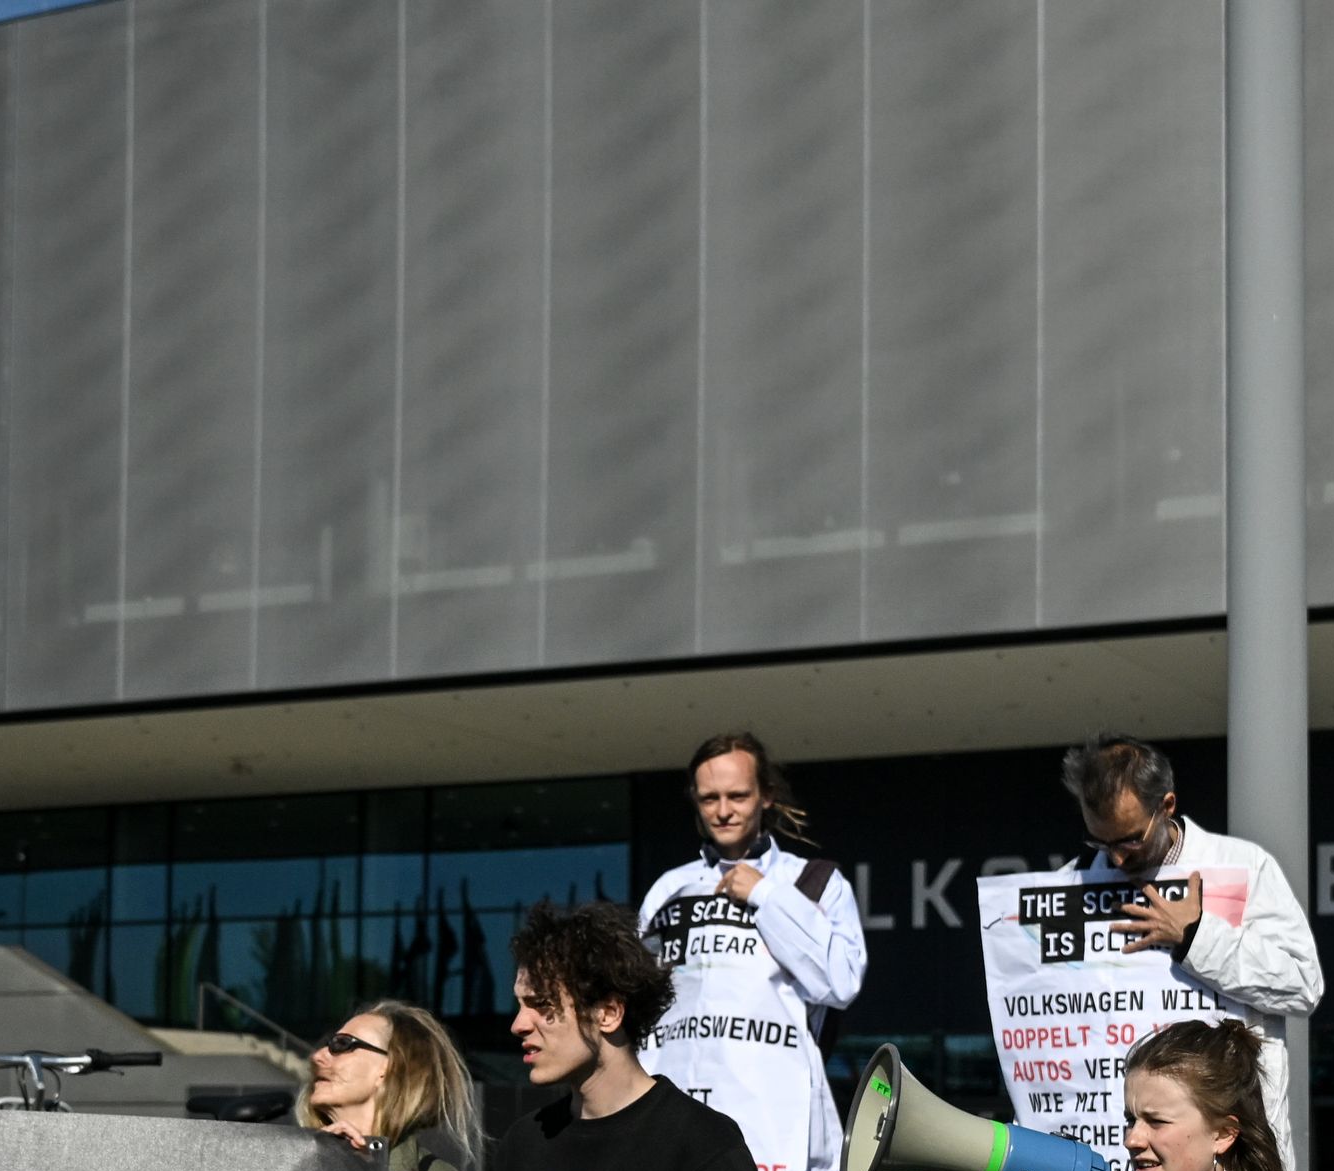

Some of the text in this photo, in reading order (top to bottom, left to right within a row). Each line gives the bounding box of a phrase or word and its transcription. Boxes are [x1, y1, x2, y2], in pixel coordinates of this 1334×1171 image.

[1021, 893, 1066, 918] THE
[663, 939, 681, 963] IS
[690, 934, 757, 956] CLEAR
[1044, 932, 1075, 957] IS
[1003, 988, 1228, 1017] VOLKSWAGEN WILL
[1002, 1024, 1091, 1050] DOPPELT
[1105, 1022, 1135, 1046] SO
[1013, 1059, 1073, 1083] AUTOS
[1028, 1091, 1112, 1114] WIE MIT
